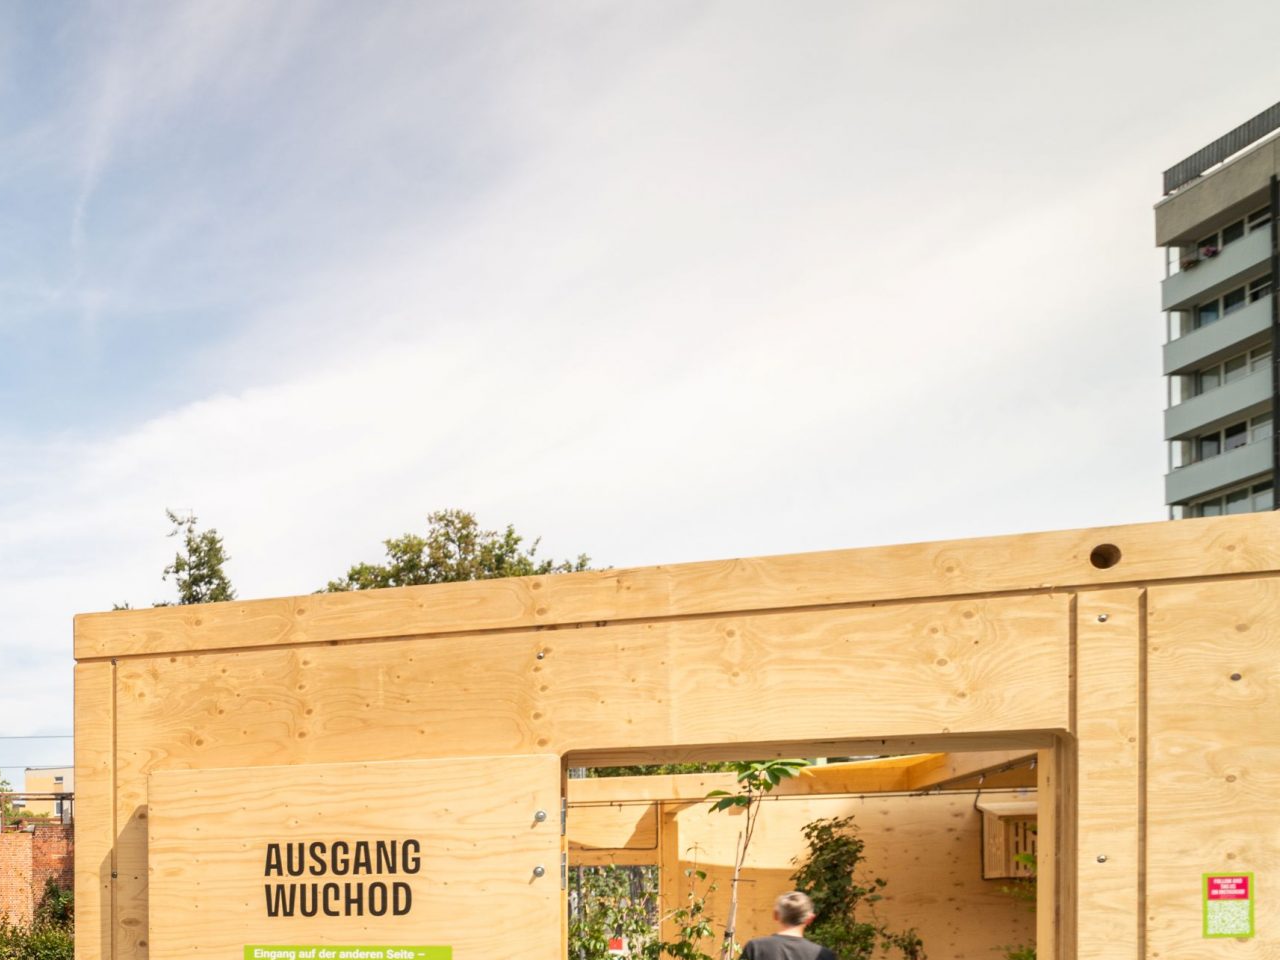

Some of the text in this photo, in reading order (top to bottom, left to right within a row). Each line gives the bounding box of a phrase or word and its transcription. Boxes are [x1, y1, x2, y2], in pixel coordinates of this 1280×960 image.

[264, 839, 421, 877] AUSGANG
[265, 881, 413, 918] WUCHOD
[254, 948, 296, 960] Eingang
[298, 948, 316, 958] auf
[319, 948, 336, 959] der
[339, 949, 383, 959] anderen
[386, 950, 415, 960] Seite
